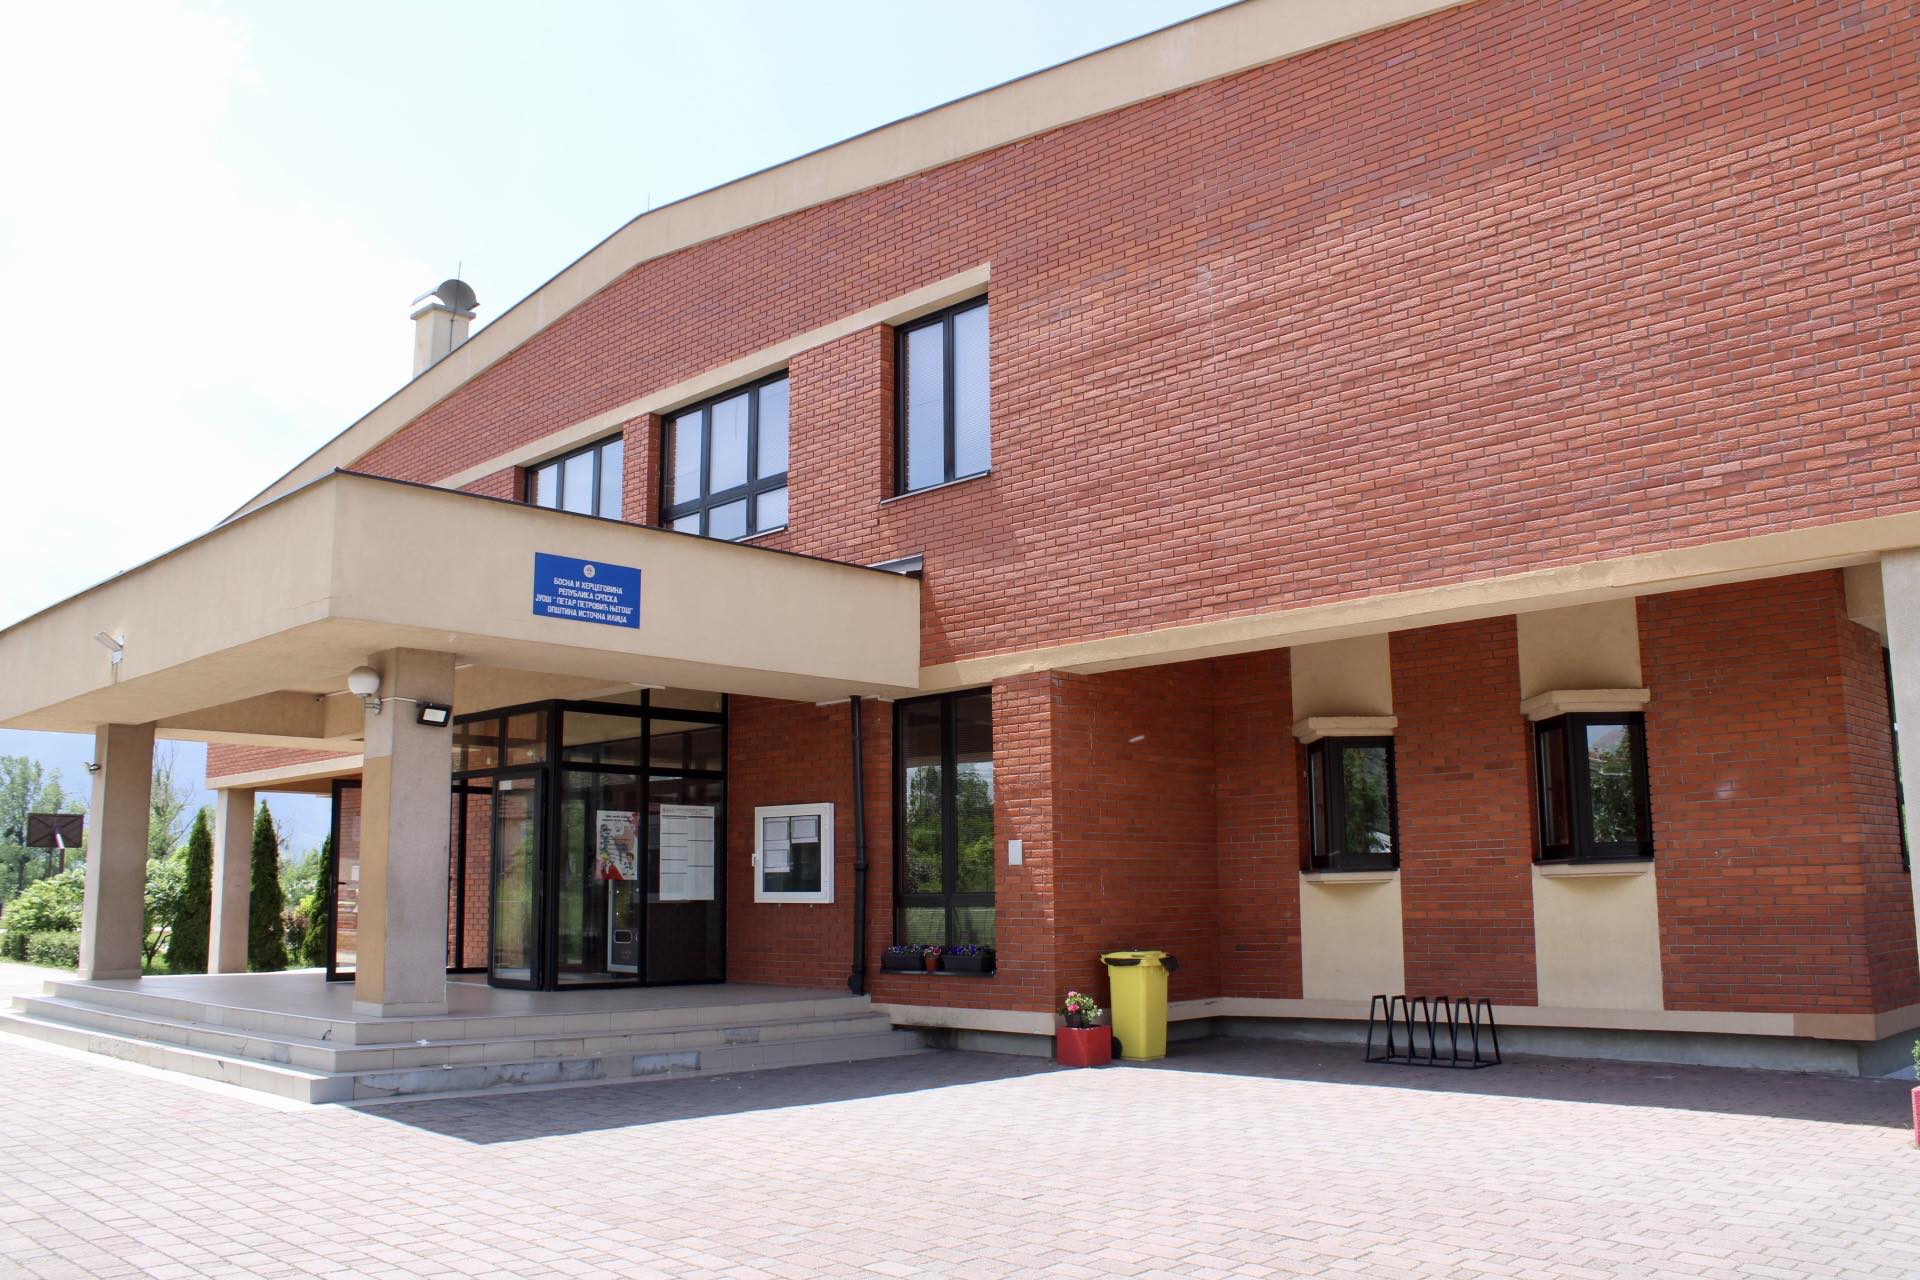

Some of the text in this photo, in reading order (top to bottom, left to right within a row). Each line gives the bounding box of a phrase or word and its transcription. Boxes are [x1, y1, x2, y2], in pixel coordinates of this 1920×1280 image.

[553, 577, 574, 586] БОСНА
[581, 581, 623, 595] ХЕРЦЕГОВИНА
[558, 587, 618, 603] РЕПУБЛИКА СРПСКА
[547, 605, 577, 616] ОПШТИНА
[578, 610, 606, 620] ИСТОЧНА
